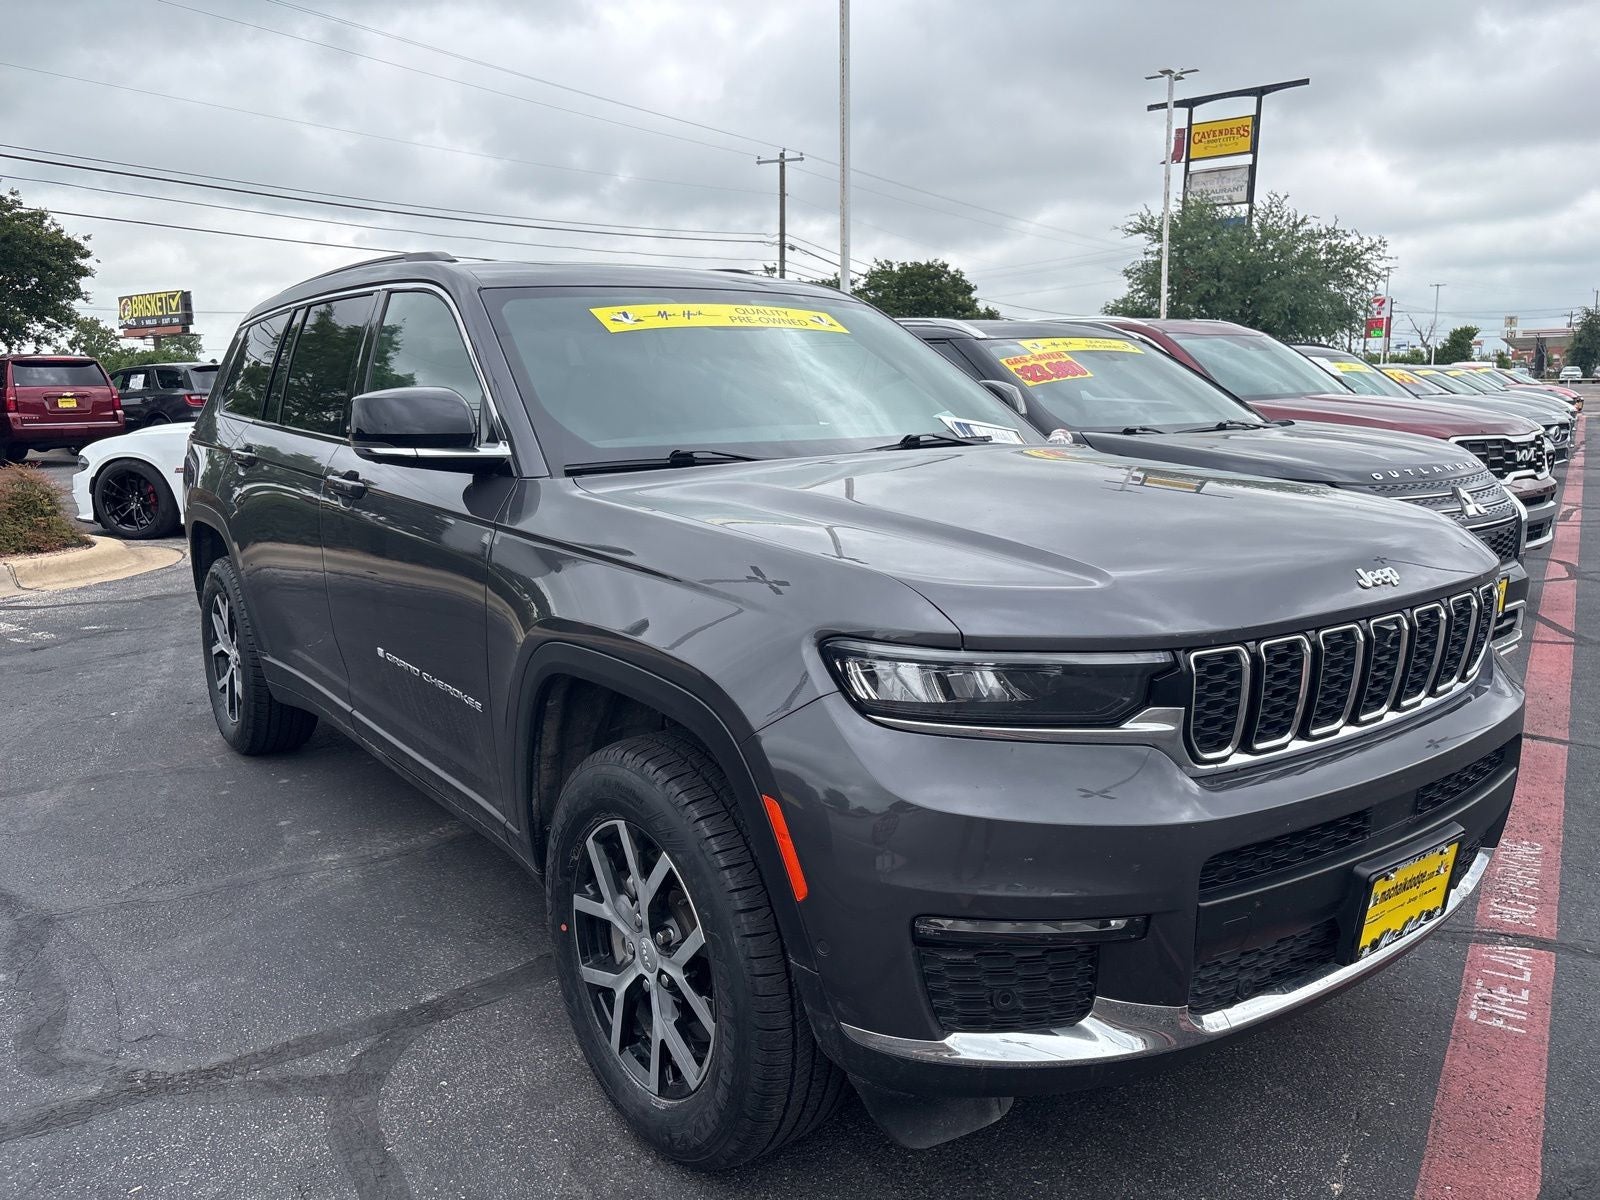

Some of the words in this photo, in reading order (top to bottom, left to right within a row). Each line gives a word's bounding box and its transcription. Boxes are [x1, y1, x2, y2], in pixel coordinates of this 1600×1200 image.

[1192, 124, 1250, 145] CAVENDER'S
[131, 292, 168, 318] BRISKET
[734, 307, 789, 317] QUALITY
[728, 315, 808, 327] PRE-OWNED
[1005, 351, 1066, 366] GAS-SAVER
[1371, 460, 1480, 480] OUTLANDER
[1355, 566, 1400, 589] Jeep
[386, 652, 419, 677] GRAND
[422, 672, 483, 713] CHEROKEE
[1494, 838, 1543, 900] PARKING
[1488, 898, 1537, 928] NO
[1481, 945, 1533, 983] LAN
[1468, 979, 1530, 1034] FIRE
